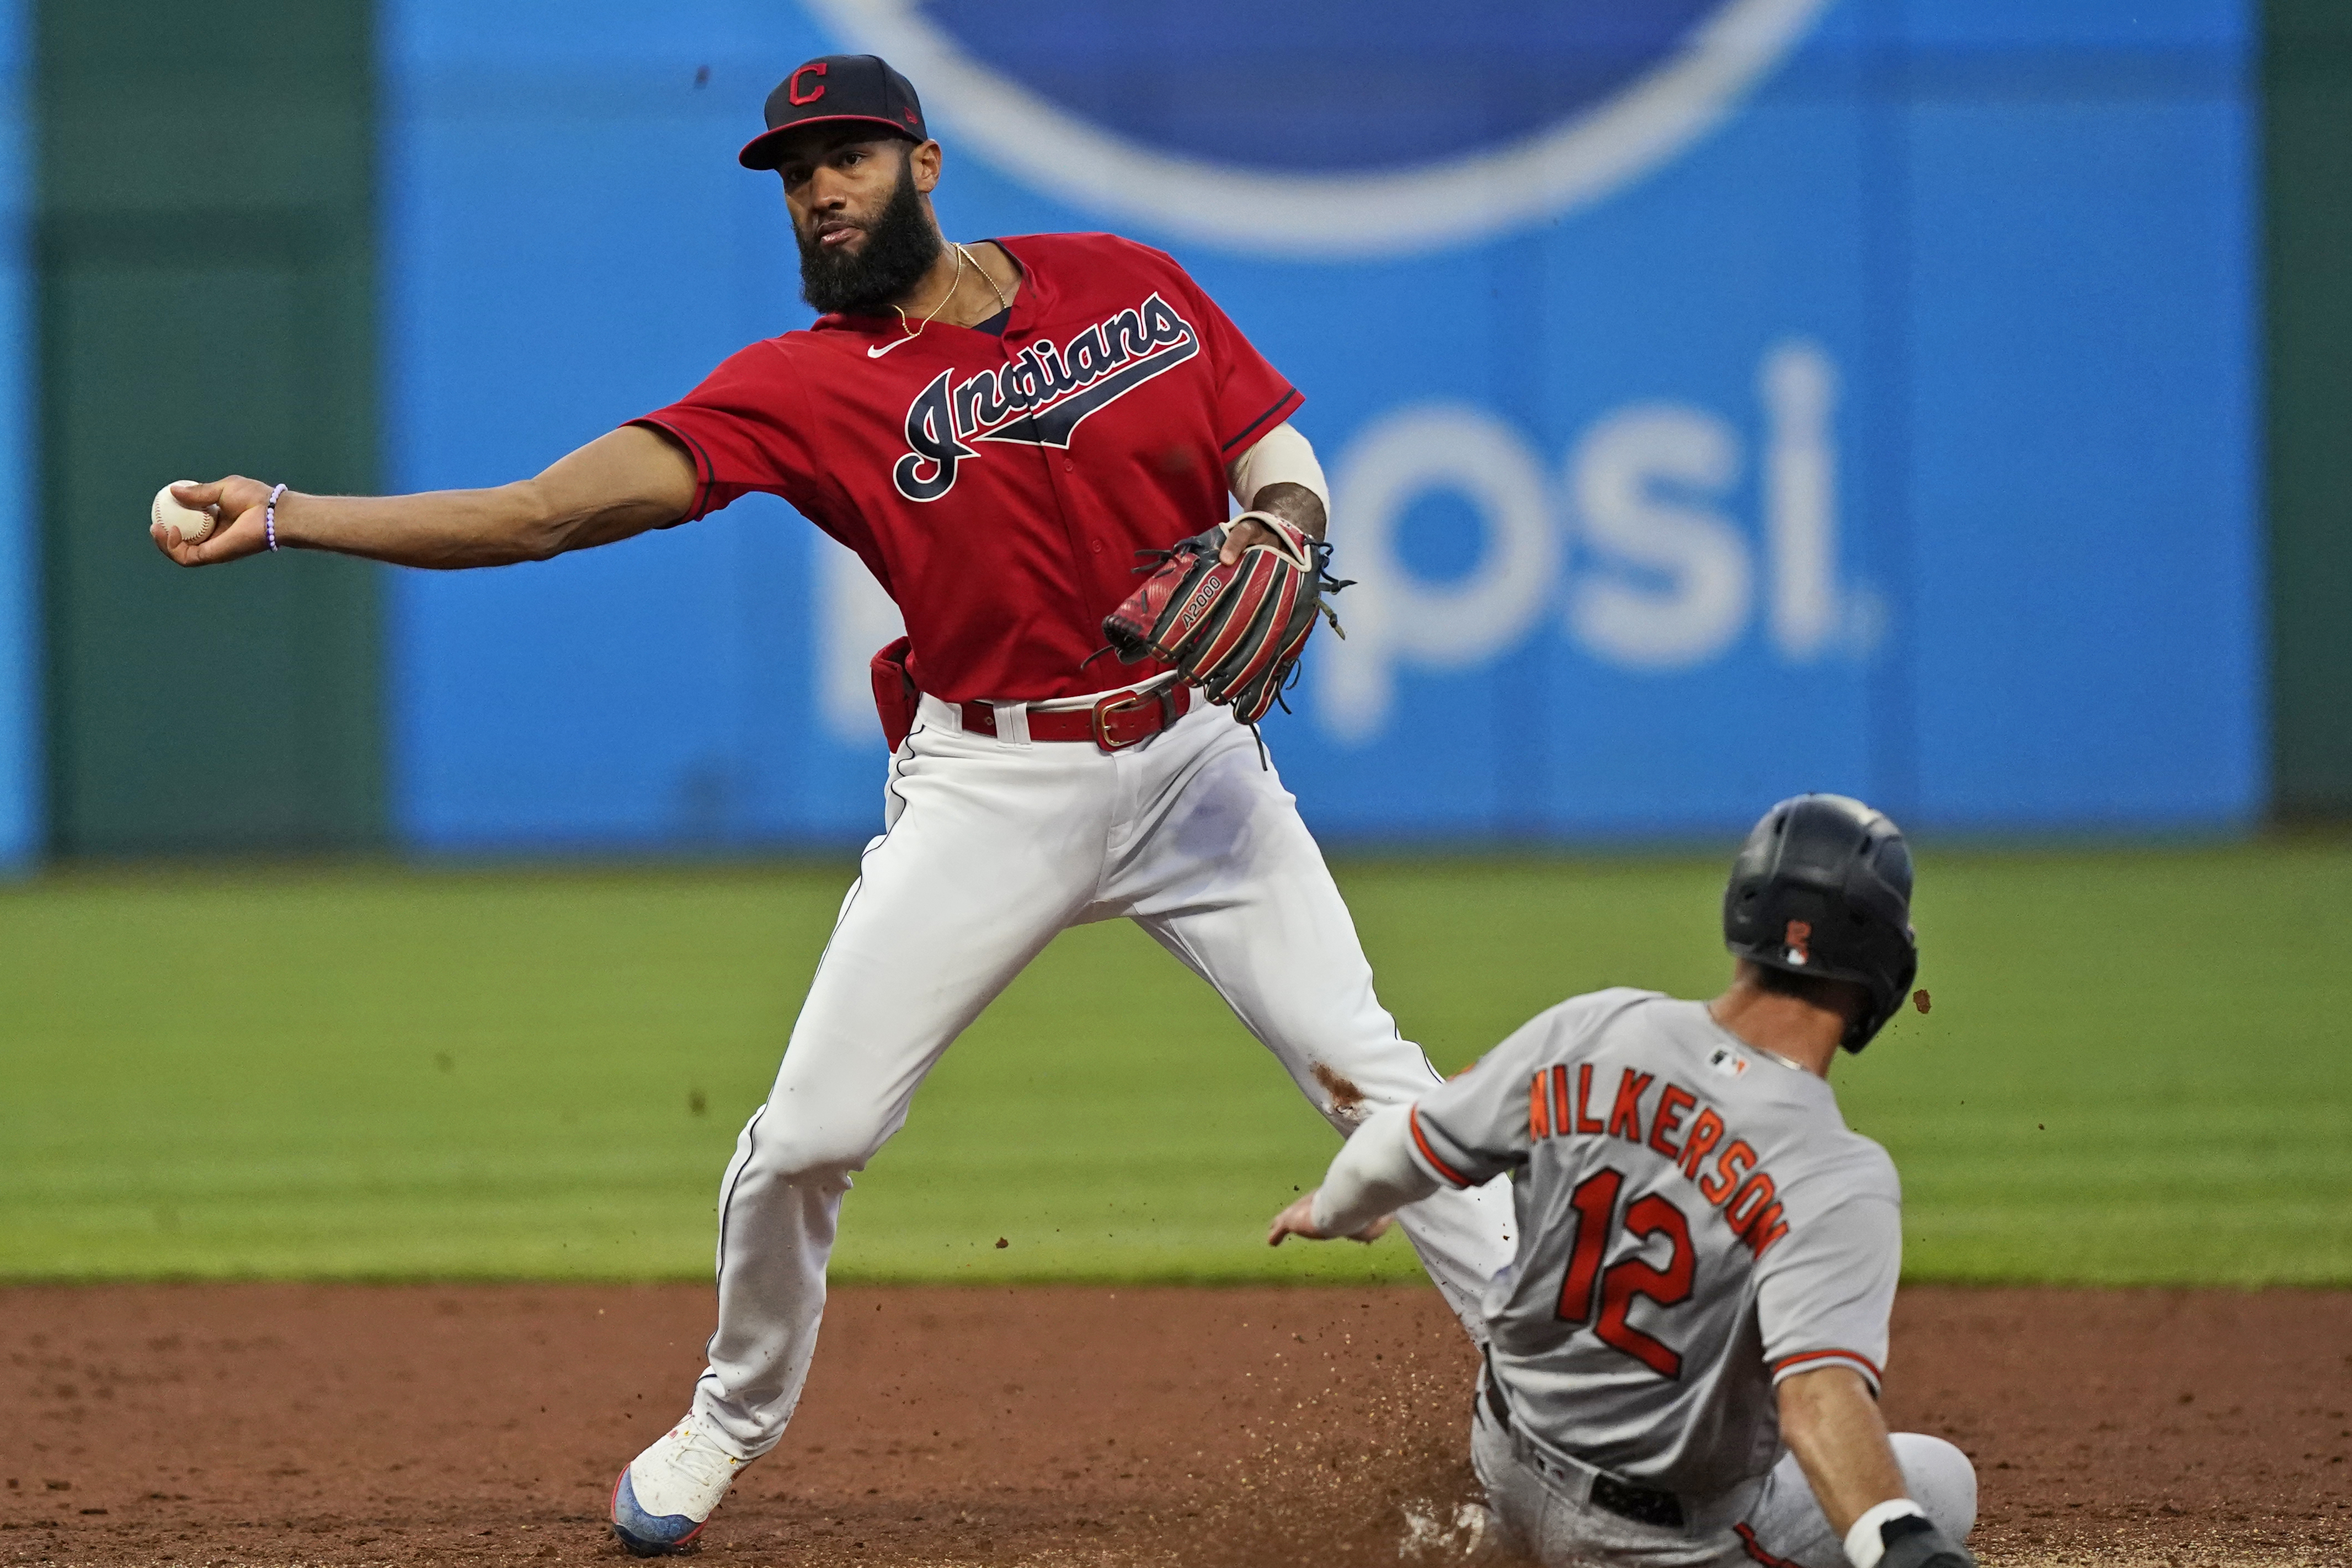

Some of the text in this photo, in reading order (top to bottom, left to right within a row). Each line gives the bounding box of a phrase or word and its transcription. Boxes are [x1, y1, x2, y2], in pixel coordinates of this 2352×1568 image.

[789, 62, 827, 106] C
[893, 291, 1200, 503] Indians
[1182, 575, 1222, 630] A2000
[1553, 1165, 1697, 1382] 12
